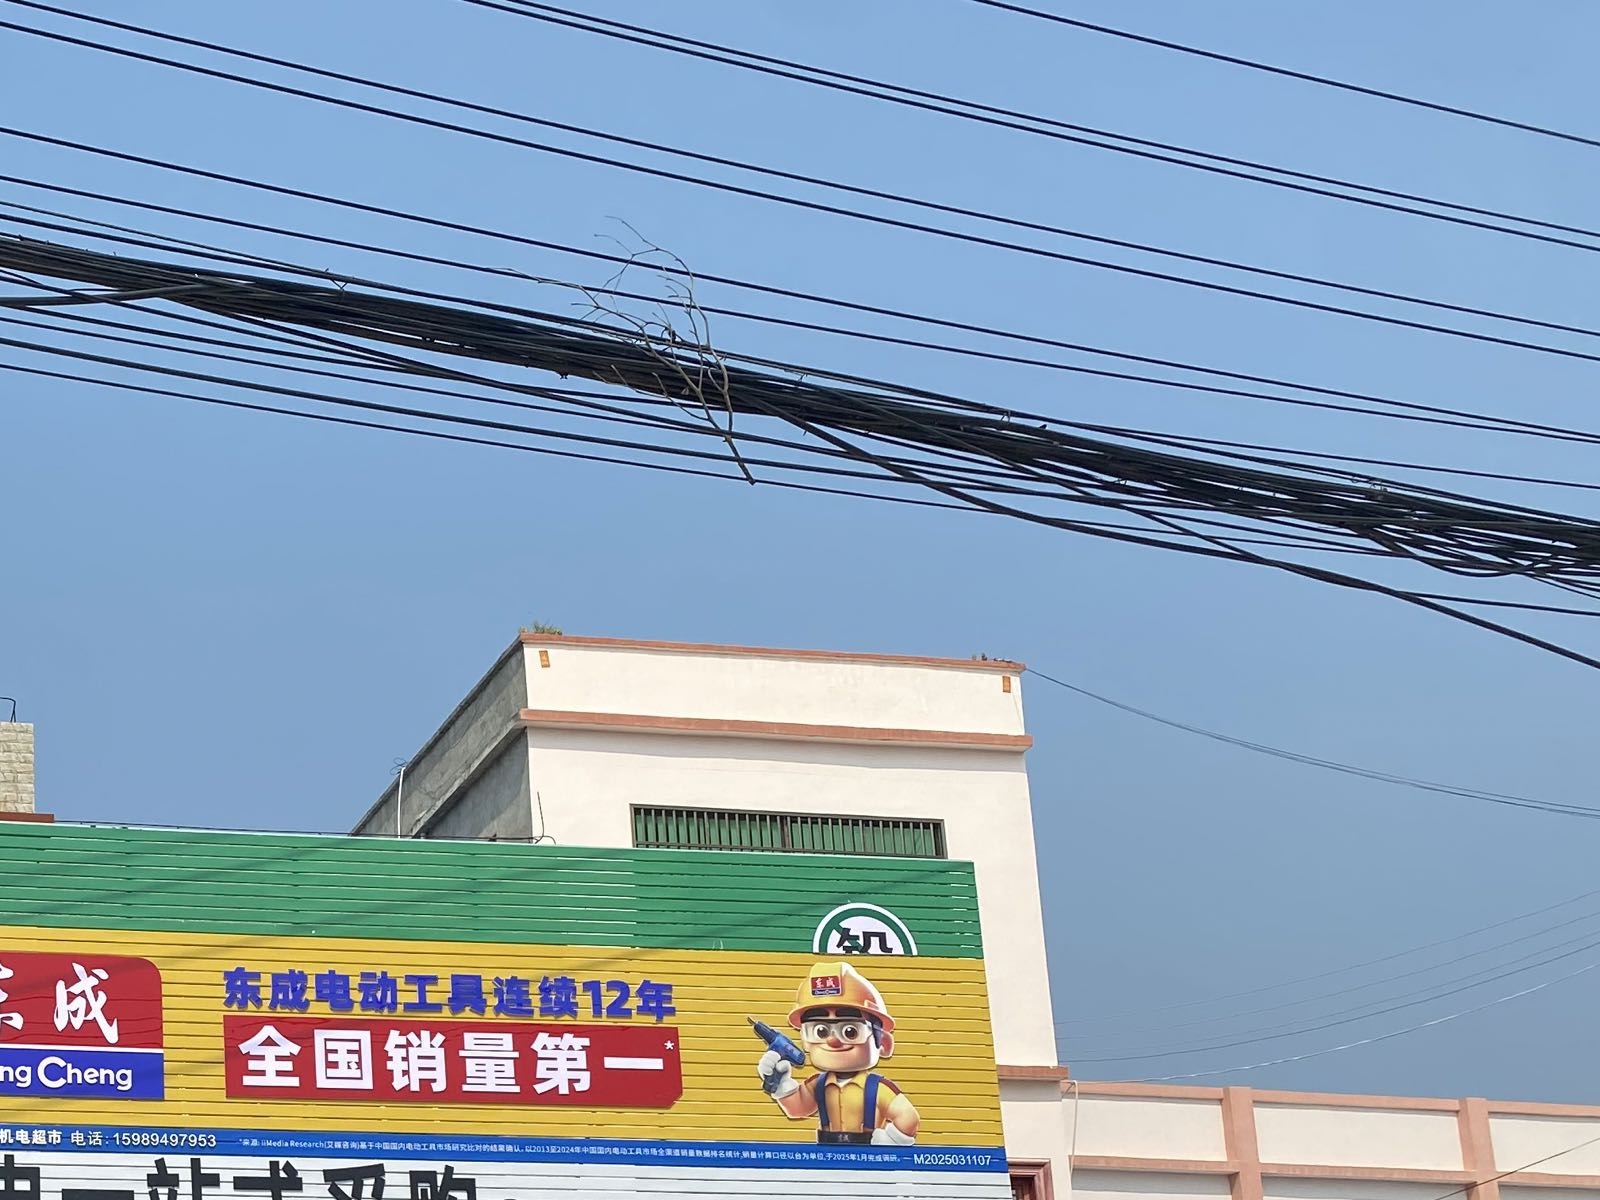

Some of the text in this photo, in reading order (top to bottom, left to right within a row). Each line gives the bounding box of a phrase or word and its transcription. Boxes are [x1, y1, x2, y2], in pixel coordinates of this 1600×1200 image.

[223, 966, 677, 1022] 东成电动工具连续12年
[913, 1153, 992, 1167] M2025031107
